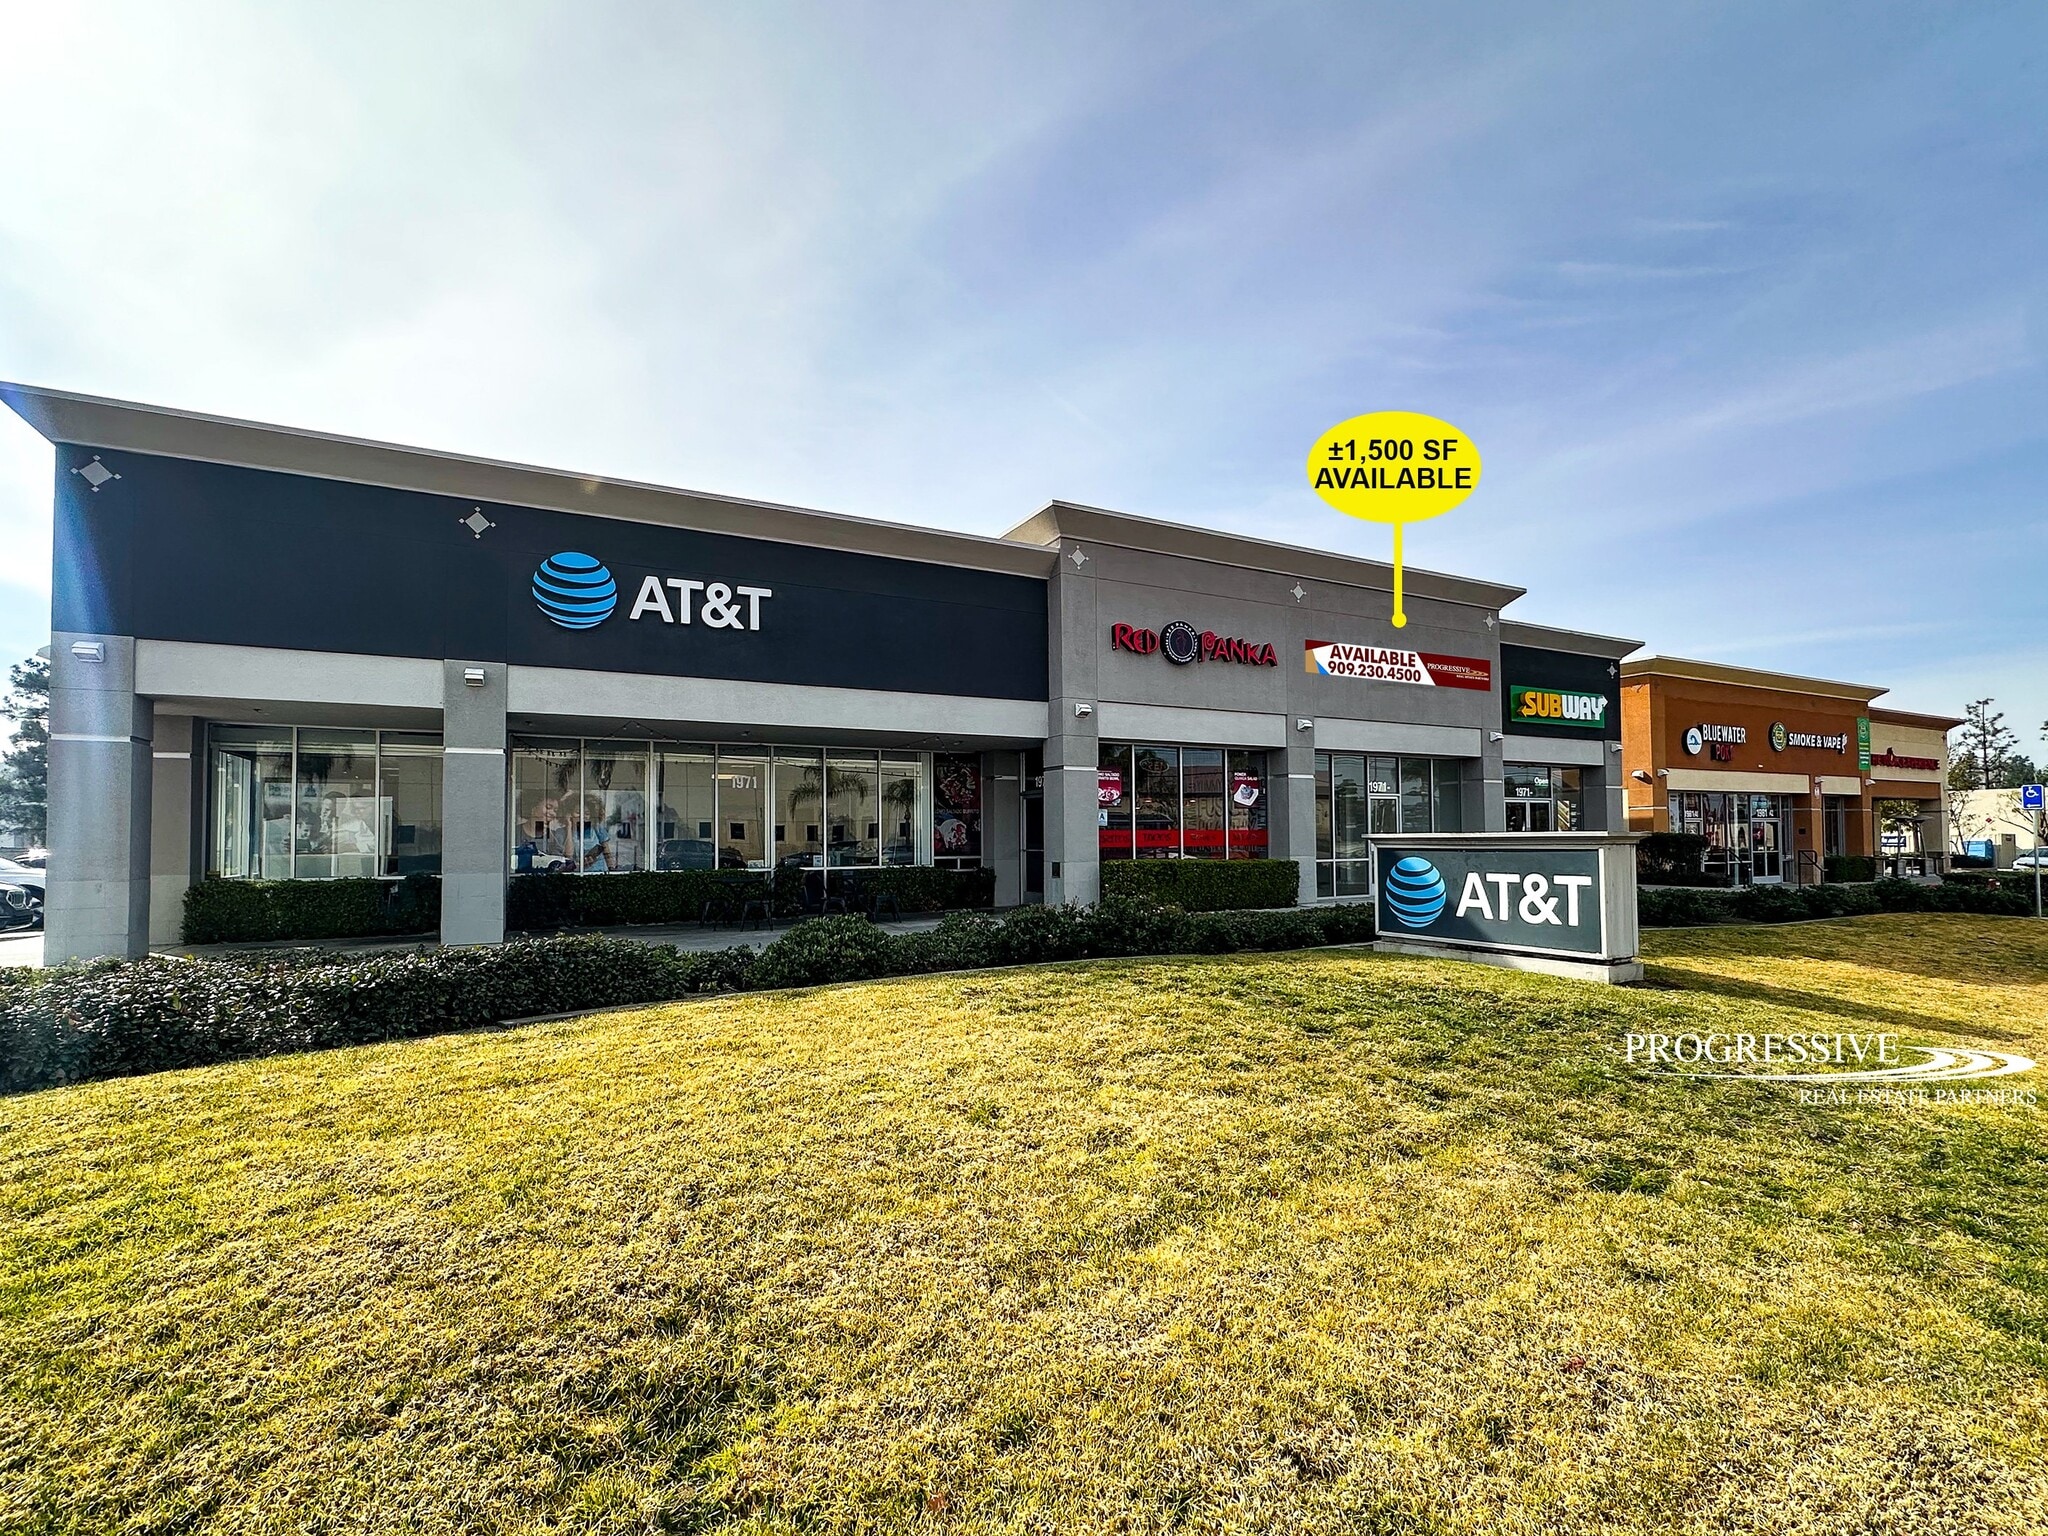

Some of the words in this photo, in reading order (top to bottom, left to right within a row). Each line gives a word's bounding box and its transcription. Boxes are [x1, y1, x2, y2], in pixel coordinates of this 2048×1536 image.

[629, 575, 773, 631] AT&T
[1198, 630, 1278, 667] PANKA
[1330, 644, 1416, 668] AVAILABLE
[1327, 660, 1422, 682] 909.230.4500
[1427, 662, 1471, 674] PROGRESSIVE
[1520, 690, 1608, 721] SUBWAY
[1702, 724, 1747, 744] BLUEWATER
[1788, 733, 1815, 748] SMOKE
[1816, 735, 1822, 748] &
[1823, 735, 1842, 749] VAPE
[731, 775, 757, 789] 1971
[1534, 776, 1549, 787] Open
[1099, 813, 1105, 821] A
[1456, 872, 1593, 927] AT&T
